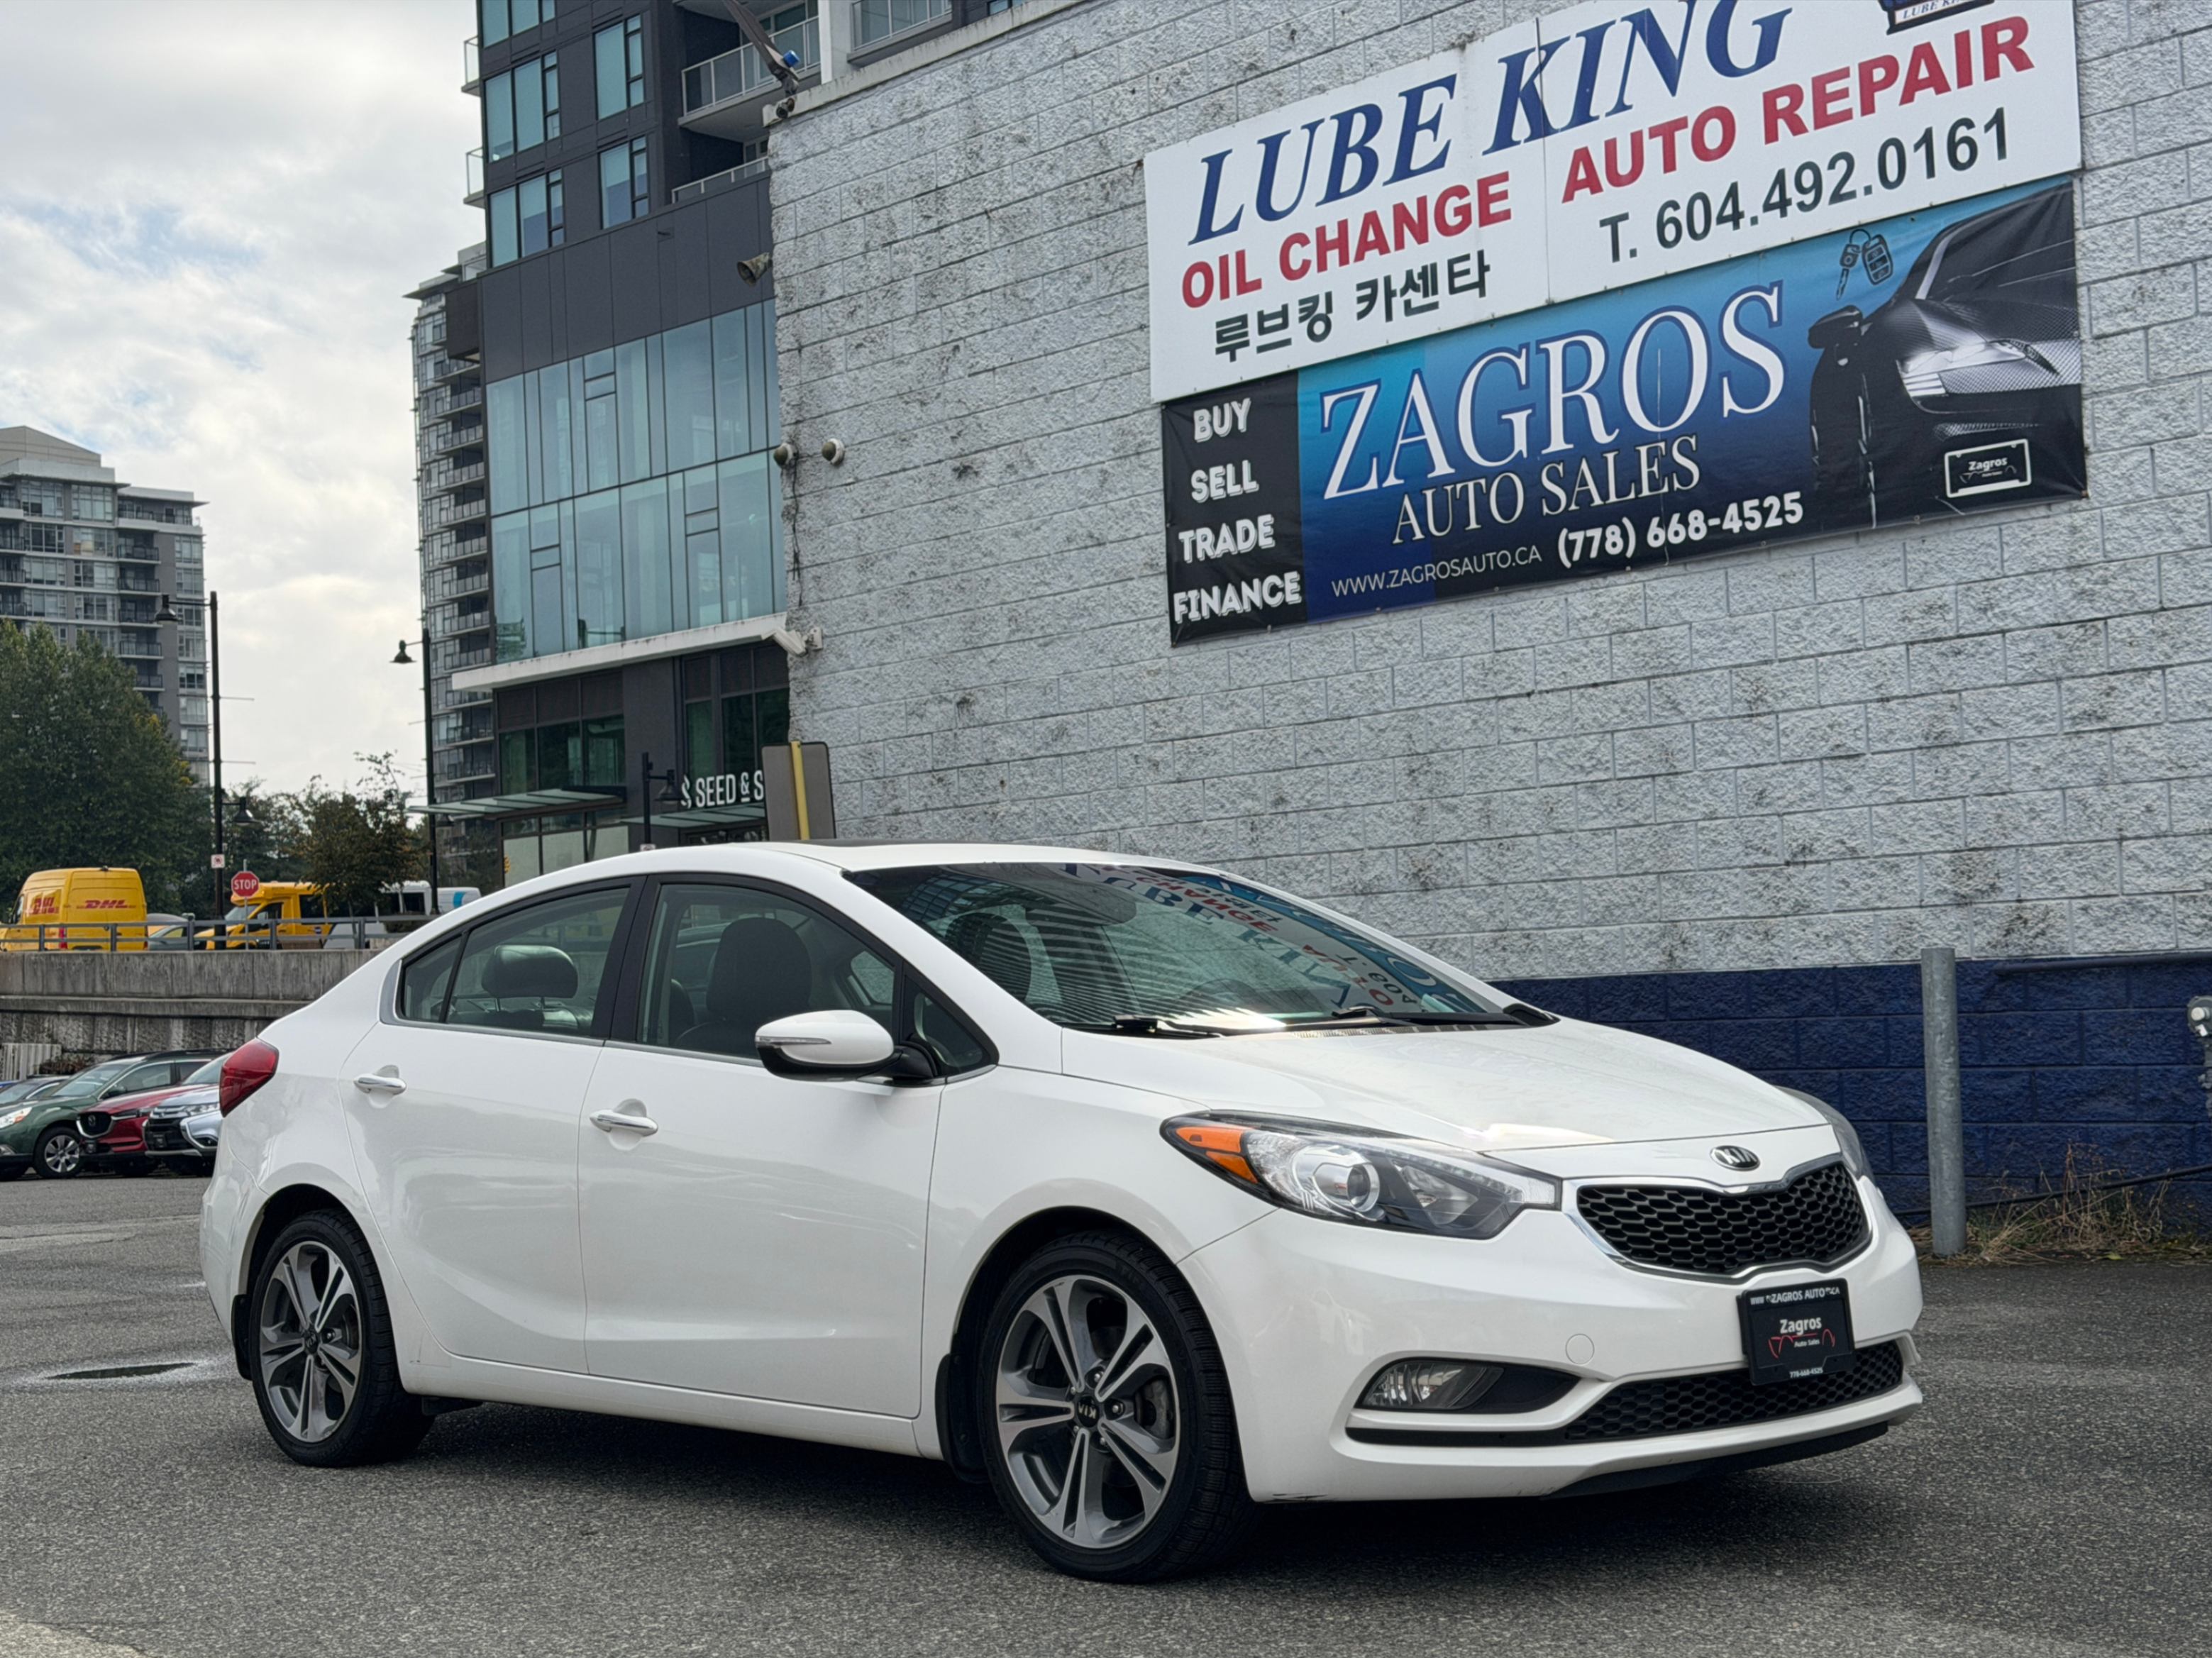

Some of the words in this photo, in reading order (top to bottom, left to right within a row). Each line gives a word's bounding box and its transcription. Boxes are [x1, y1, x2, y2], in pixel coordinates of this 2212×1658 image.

[1188, 74, 1457, 245] LUBE
[1482, 0, 1792, 155] KING
[1561, 106, 1736, 204] AUTO
[1762, 16, 2035, 145] REPAIR
[1599, 212, 1637, 262] T.
[1657, 107, 2008, 249] 604.492.0161
[1182, 250, 1262, 308] OIL
[1279, 171, 1511, 281] CHANGE
[1215, 292, 1333, 363] 루브킹
[1356, 250, 1491, 323] 카센타
[1320, 281, 1784, 499] ZAGROS
[1193, 398, 1251, 442] BUY
[1190, 460, 1259, 502] SELL
[1393, 472, 1525, 544] AUTO
[1541, 433, 1701, 517] SALES
[1969, 458, 2008, 471] Zagros
[1179, 514, 1276, 563] TRADE
[1559, 517, 1636, 568] (778)
[1647, 492, 1803, 548] 668-4525
[1332, 545, 1542, 597] WWW.ZAGROSAUTO.CA
[1173, 571, 1301, 624] FINANCE
[696, 775, 736, 807] SEED
[84, 900, 128, 909] DHL
[234, 879, 257, 890] STOP
[1780, 1317, 1822, 1335] Zagros
